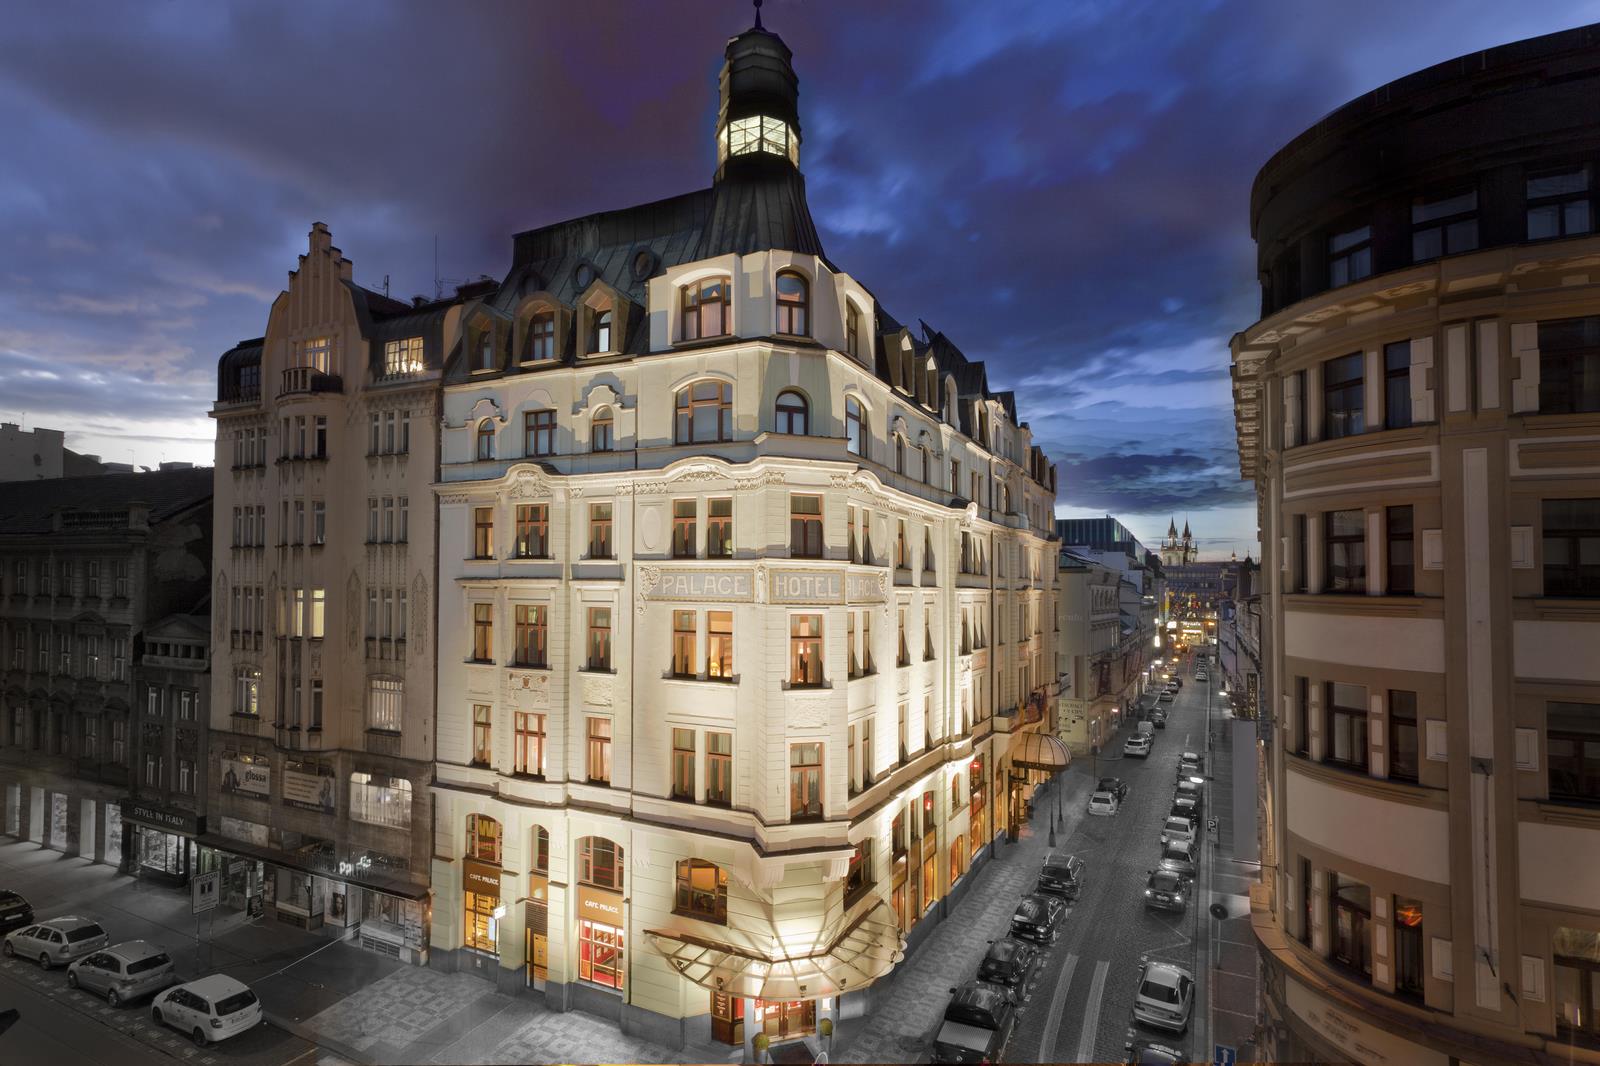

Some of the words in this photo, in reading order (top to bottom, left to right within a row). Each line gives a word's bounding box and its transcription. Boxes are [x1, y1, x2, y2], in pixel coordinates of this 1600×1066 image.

[662, 575, 748, 595] PALACE
[775, 575, 841, 598] HOTEL
[245, 769, 267, 783] glossa
[134, 807, 153, 819] STYLE
[165, 814, 185, 826] ITALY
[600, 903, 620, 914] PALACE
